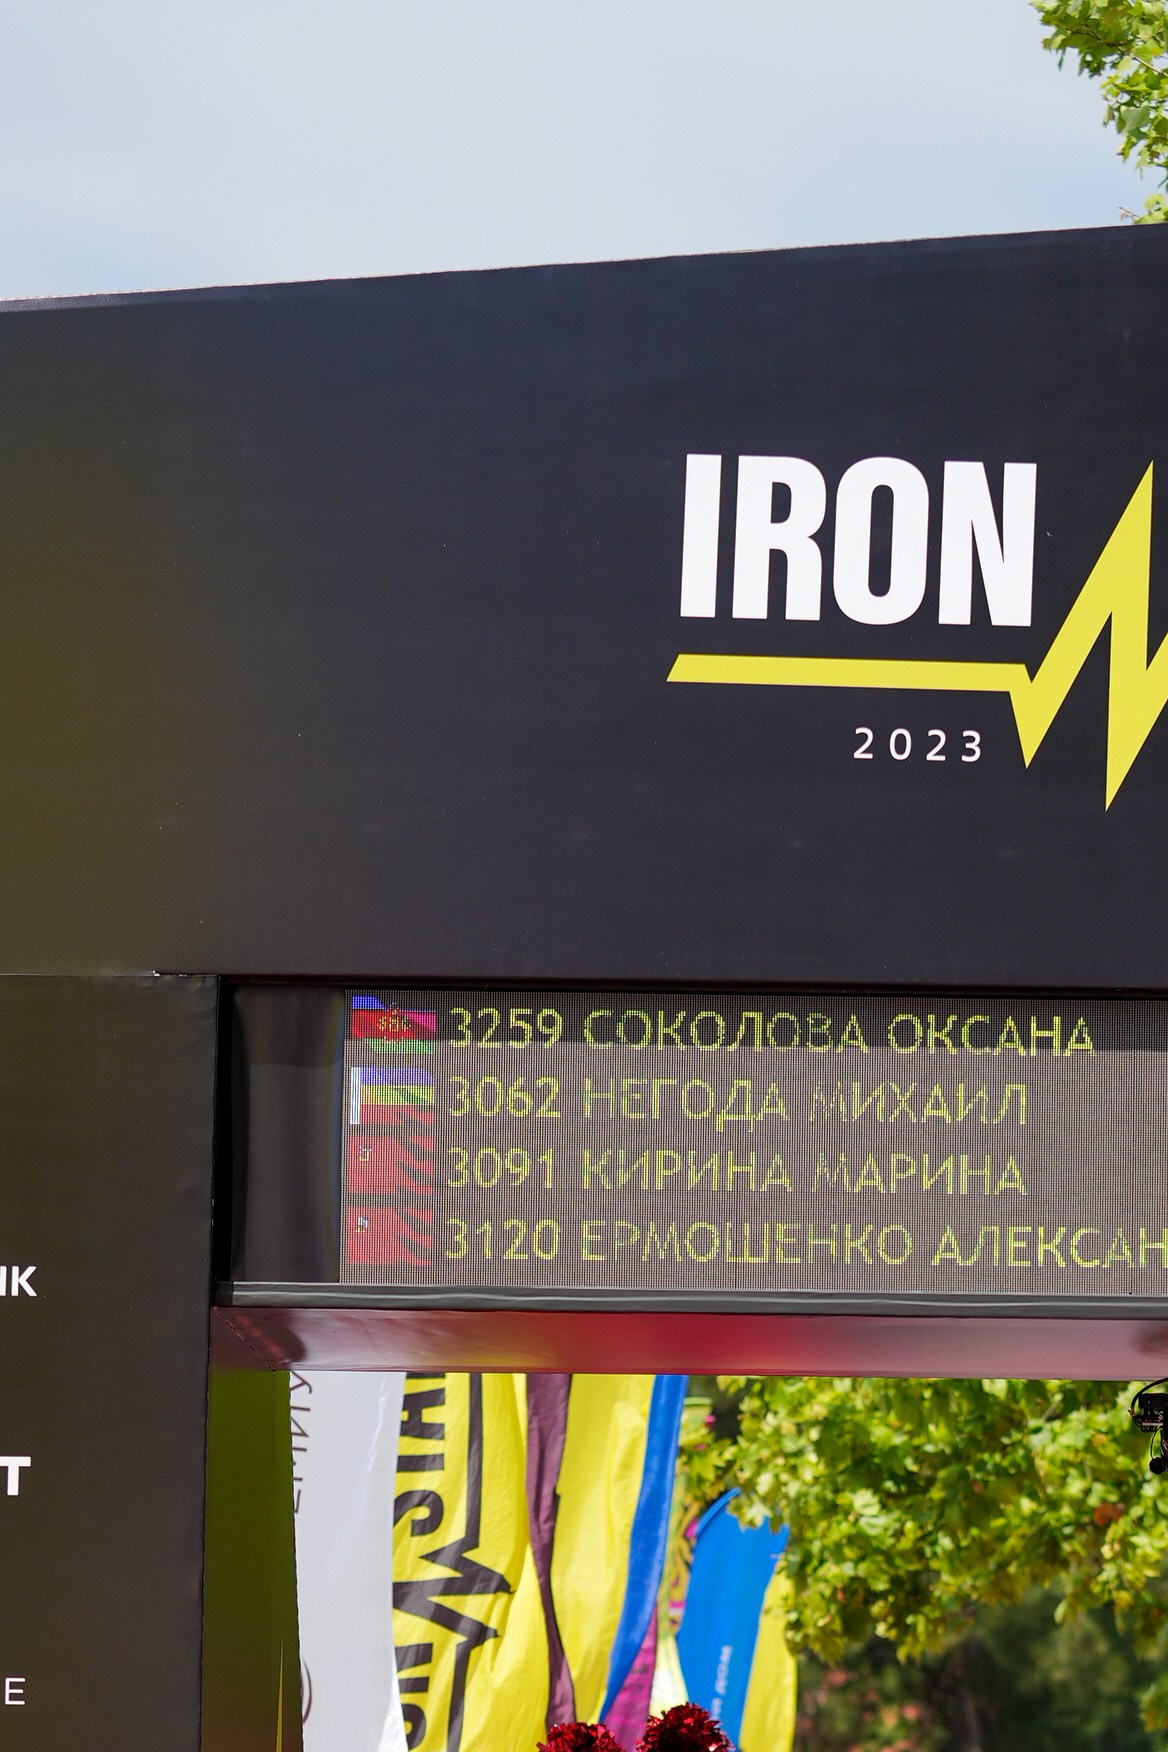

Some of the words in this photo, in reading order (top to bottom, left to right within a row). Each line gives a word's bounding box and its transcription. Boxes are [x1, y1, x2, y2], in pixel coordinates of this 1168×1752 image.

[680, 453, 1037, 627] IRON
[853, 727, 982, 763] 2023
[450, 1007, 563, 1048] 3259
[583, 1009, 868, 1053] СОКОЛОВА
[887, 1013, 1095, 1056] ОКСАНА
[449, 1075, 561, 1118] 3062
[583, 1076, 789, 1132] НЕГОДА
[809, 1081, 1027, 1124] МИХАИЛ
[447, 1146, 554, 1189] 3091
[583, 1148, 793, 1192] КИРИНА
[812, 1152, 1027, 1196] МАРИНА
[446, 1218, 560, 1260] 3120
[582, 1219, 913, 1266] ЕРМОШЕНКО
